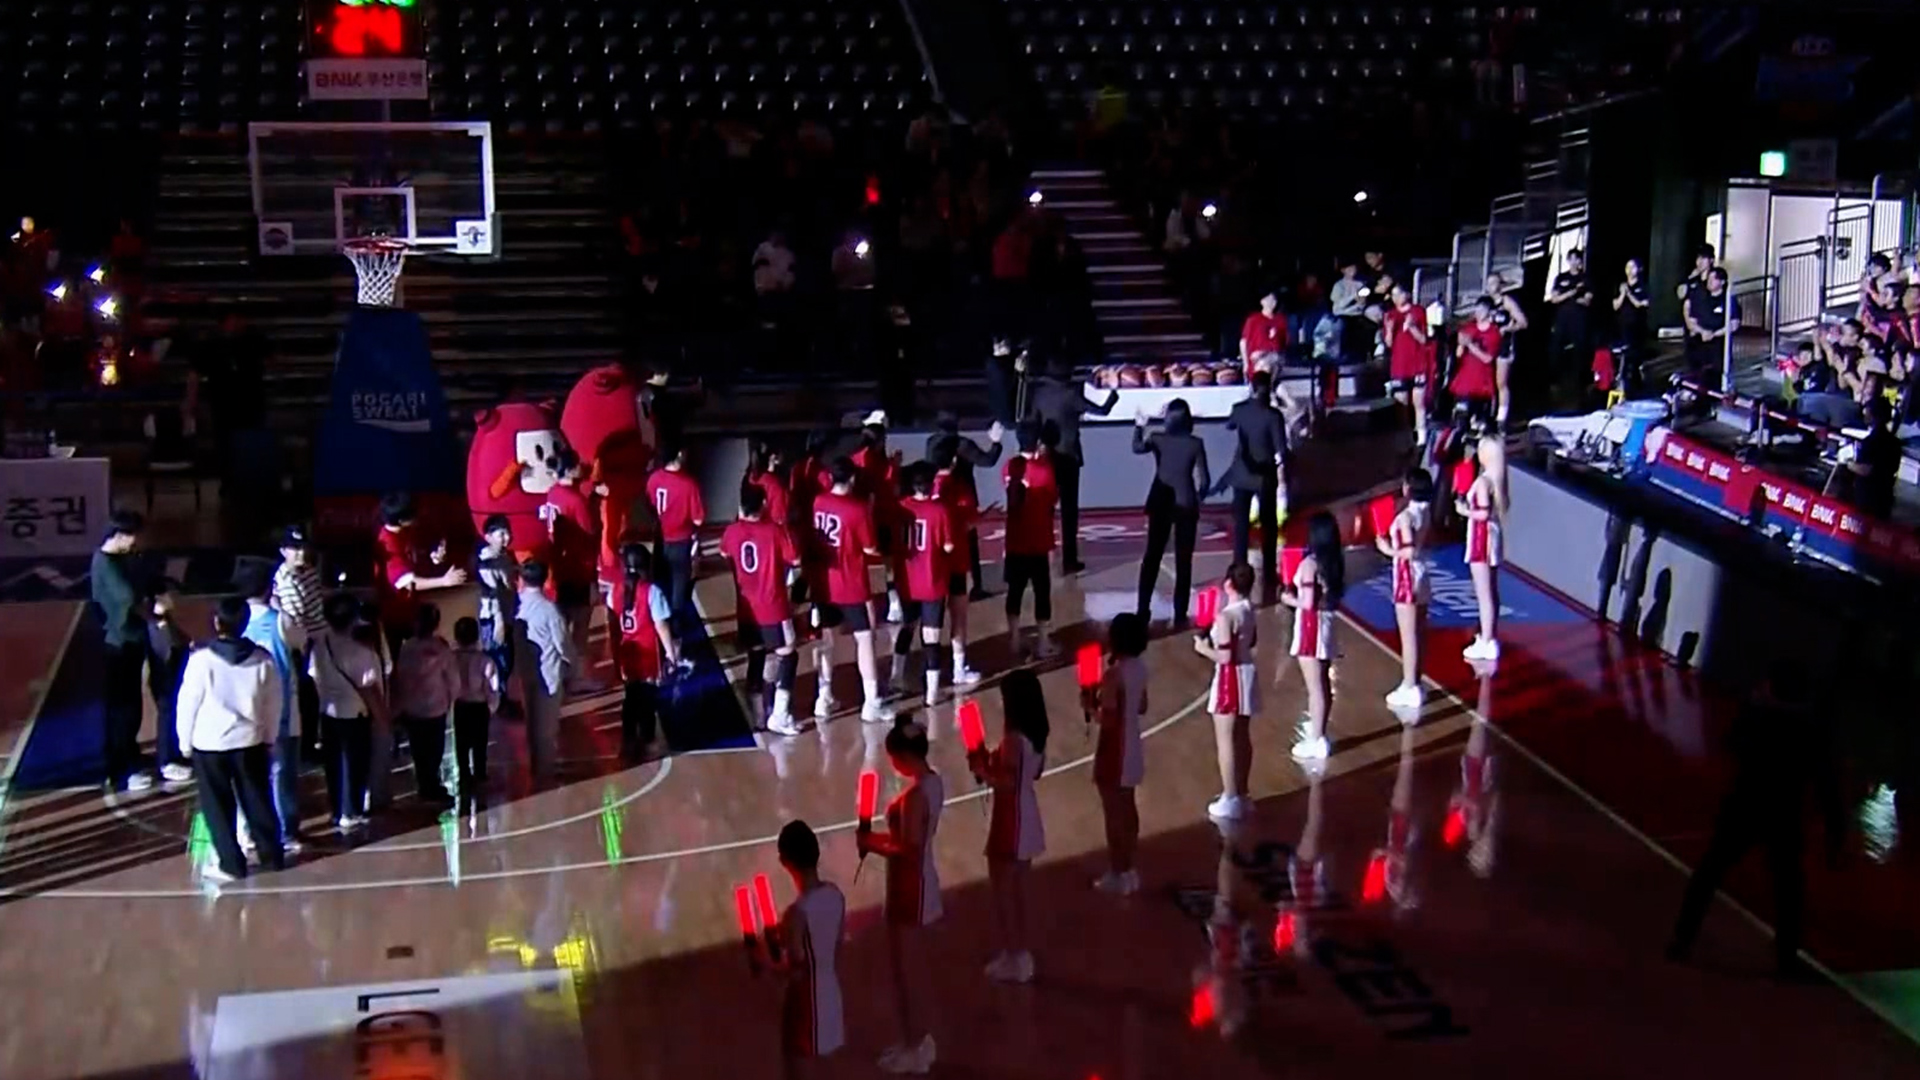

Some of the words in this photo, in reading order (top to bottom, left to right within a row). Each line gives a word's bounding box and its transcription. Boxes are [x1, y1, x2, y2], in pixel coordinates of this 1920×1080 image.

[315, 72, 361, 87] BNK
[352, 391, 426, 407] POCARI
[352, 405, 419, 419] SWEAT
[4, 495, 87, 539] 증권
[1782, 492, 1806, 515] BNK
[1810, 503, 1835, 526] BNK
[1840, 514, 1864, 535] BNK
[814, 511, 841, 547] 12
